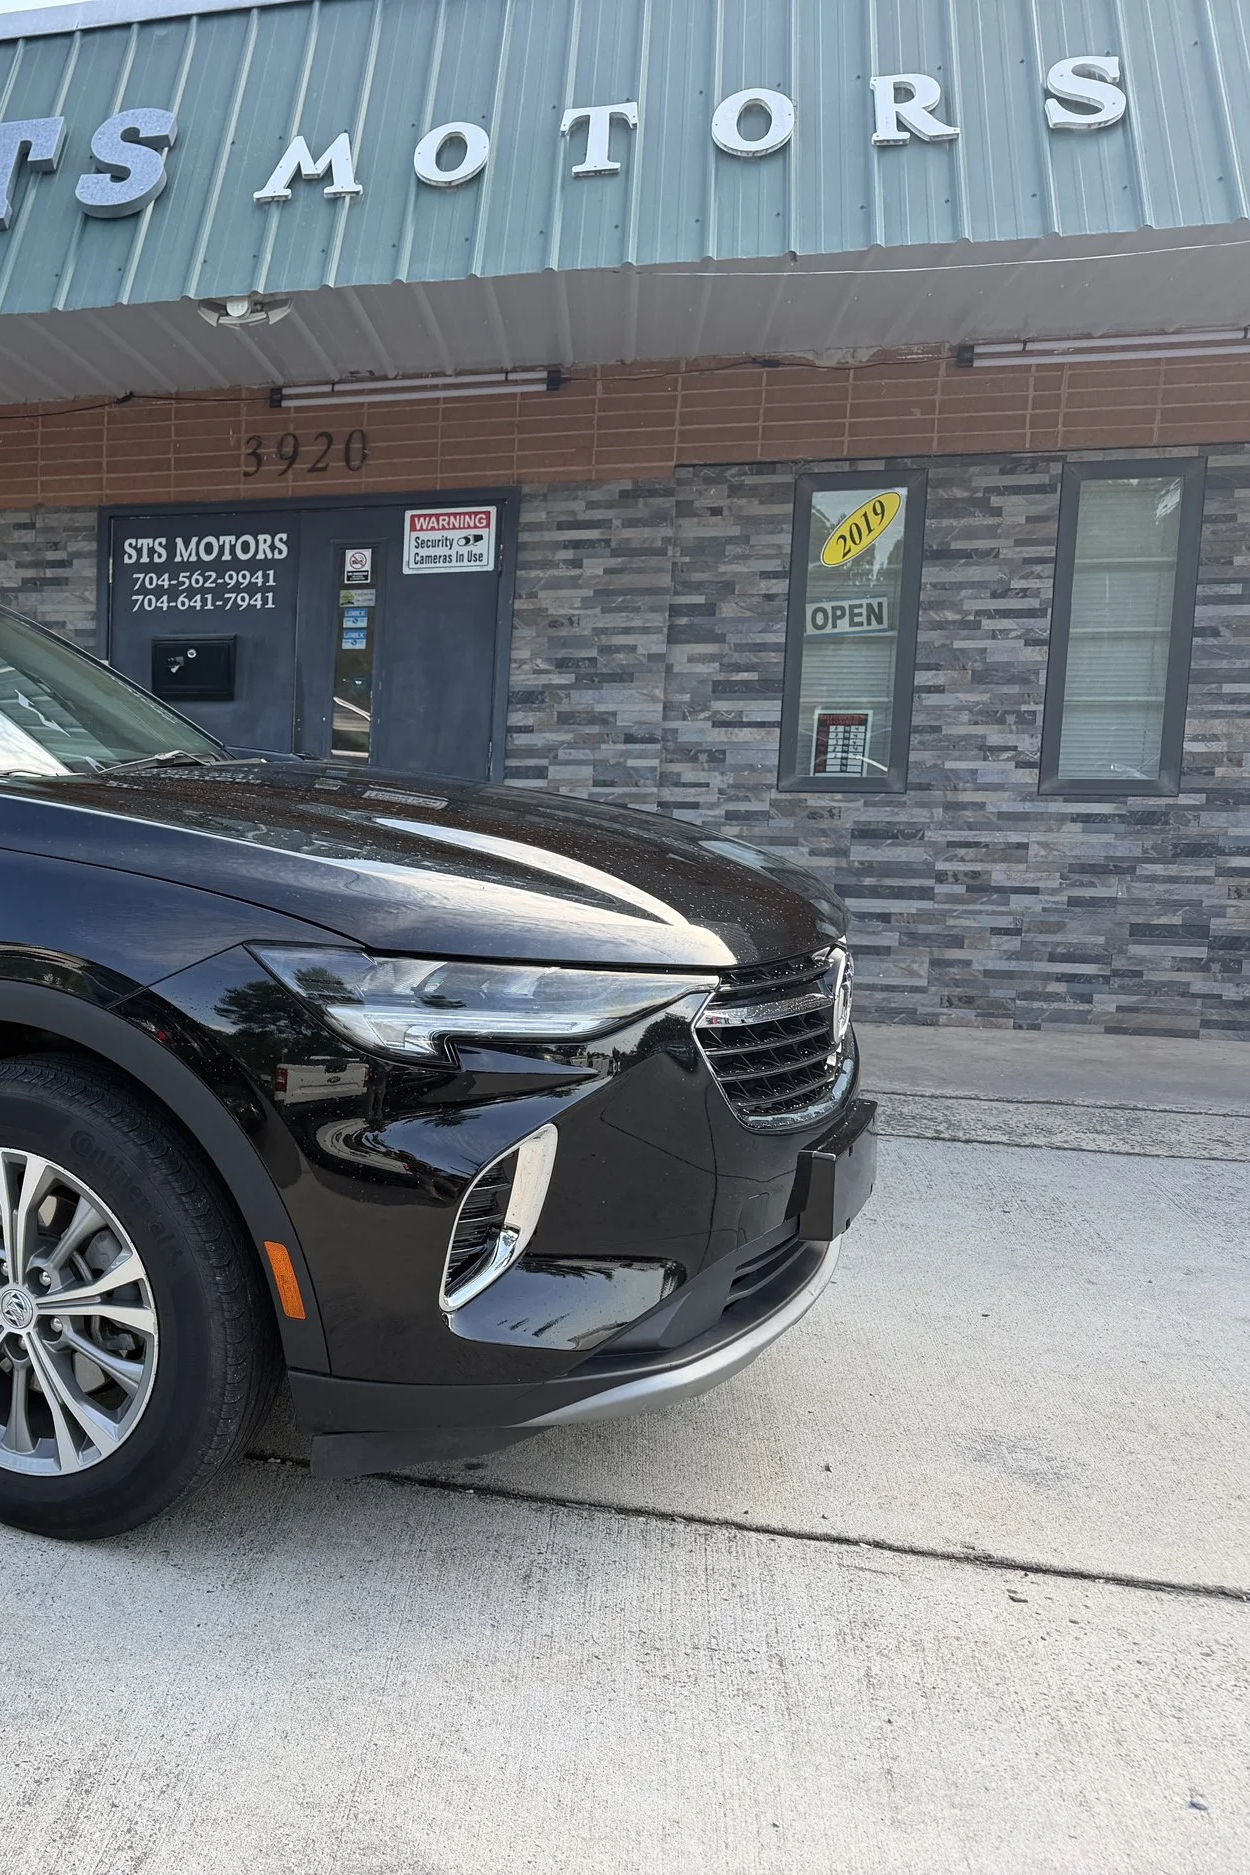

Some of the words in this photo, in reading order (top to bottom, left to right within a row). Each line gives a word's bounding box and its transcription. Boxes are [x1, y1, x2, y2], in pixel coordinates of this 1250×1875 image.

[253, 55, 1127, 199] MOTORS
[243, 428, 369, 478] 3920
[414, 513, 487, 531] WARNING
[835, 498, 887, 560] 2019
[123, 537, 168, 564] STS
[174, 532, 289, 563] MOTORS
[414, 535, 454, 550] Security
[413, 552, 453, 566] Cameras
[455, 550, 465, 564] In
[467, 550, 484, 563] Use
[132, 569, 277, 591] 704-562-9941
[131, 592, 276, 612] 704-641-7941
[810, 600, 885, 631] OPEN
